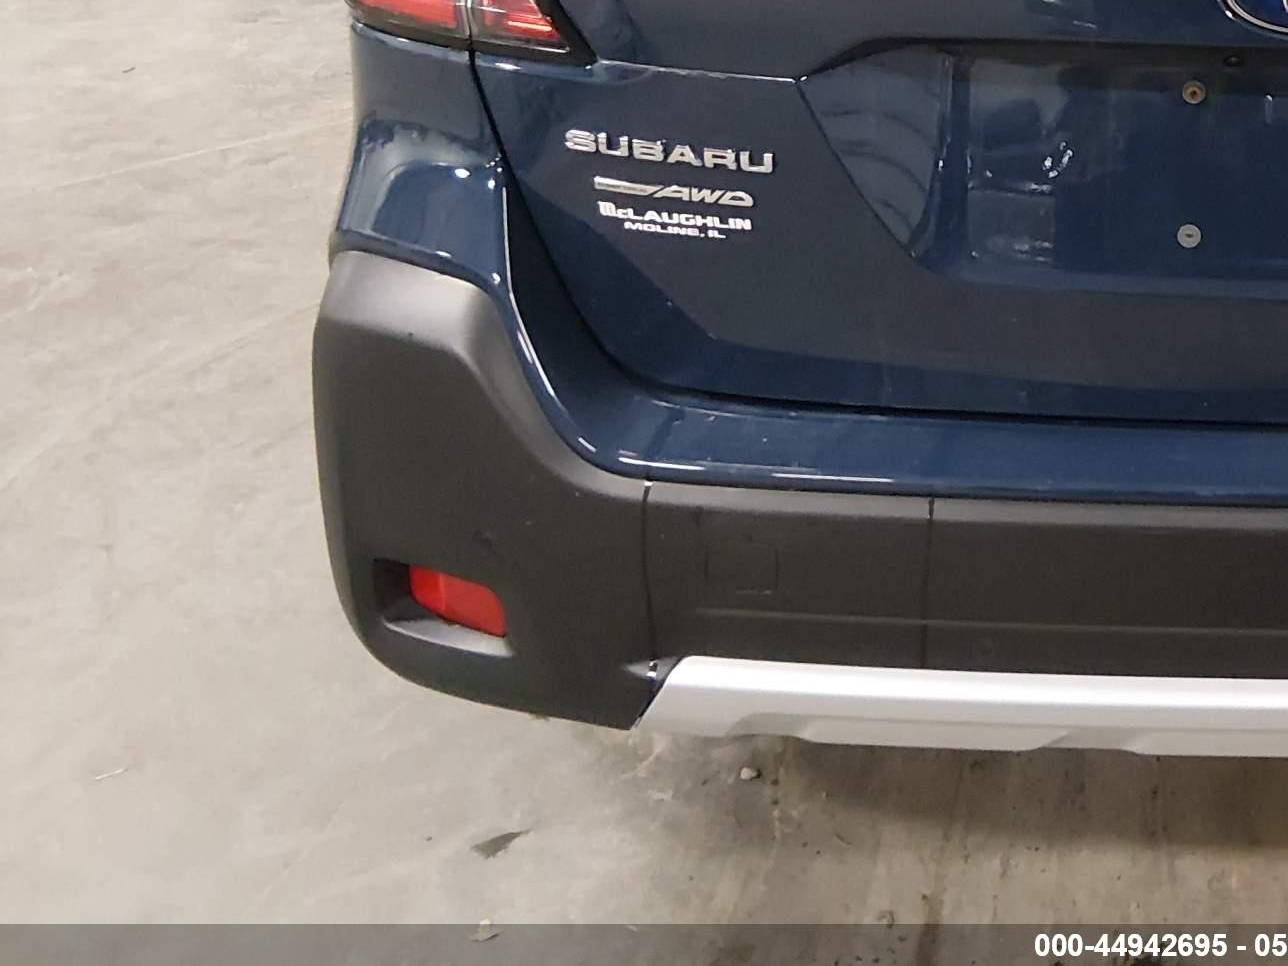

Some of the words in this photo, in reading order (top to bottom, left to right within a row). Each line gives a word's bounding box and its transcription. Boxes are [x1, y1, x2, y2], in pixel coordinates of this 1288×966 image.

[564, 129, 774, 174] SUBARU
[652, 184, 754, 207] AWD
[707, 229, 727, 239] IL
